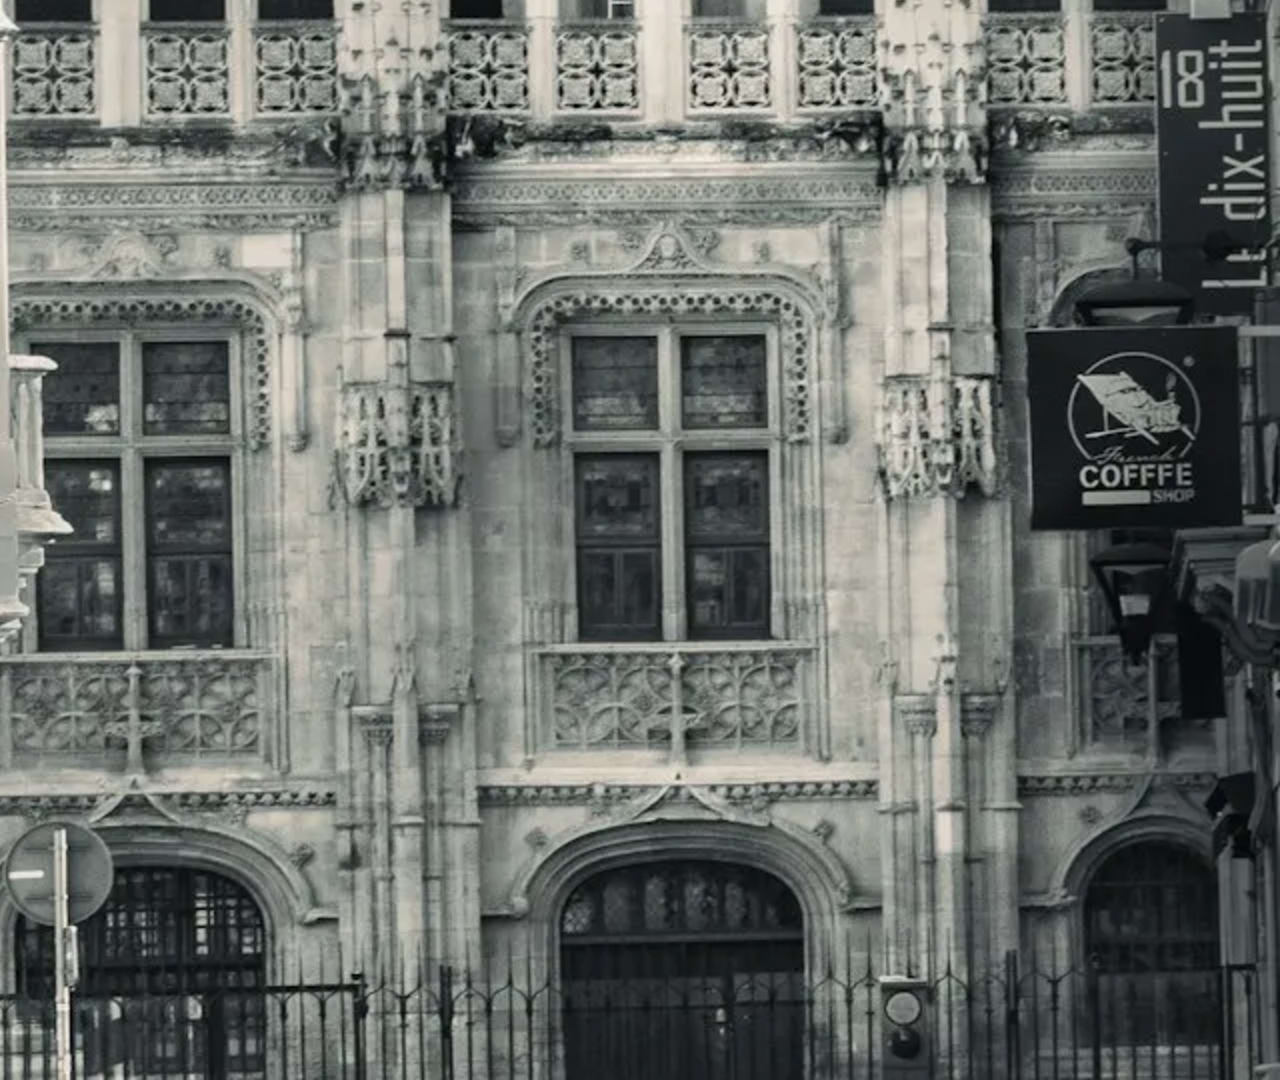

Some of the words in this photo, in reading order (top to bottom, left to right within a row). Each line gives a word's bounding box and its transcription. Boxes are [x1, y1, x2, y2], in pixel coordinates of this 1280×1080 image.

[1160, 49, 1206, 110] 18
[1197, 38, 1267, 221] dix-huit
[1152, 489, 1196, 503] SHOP
